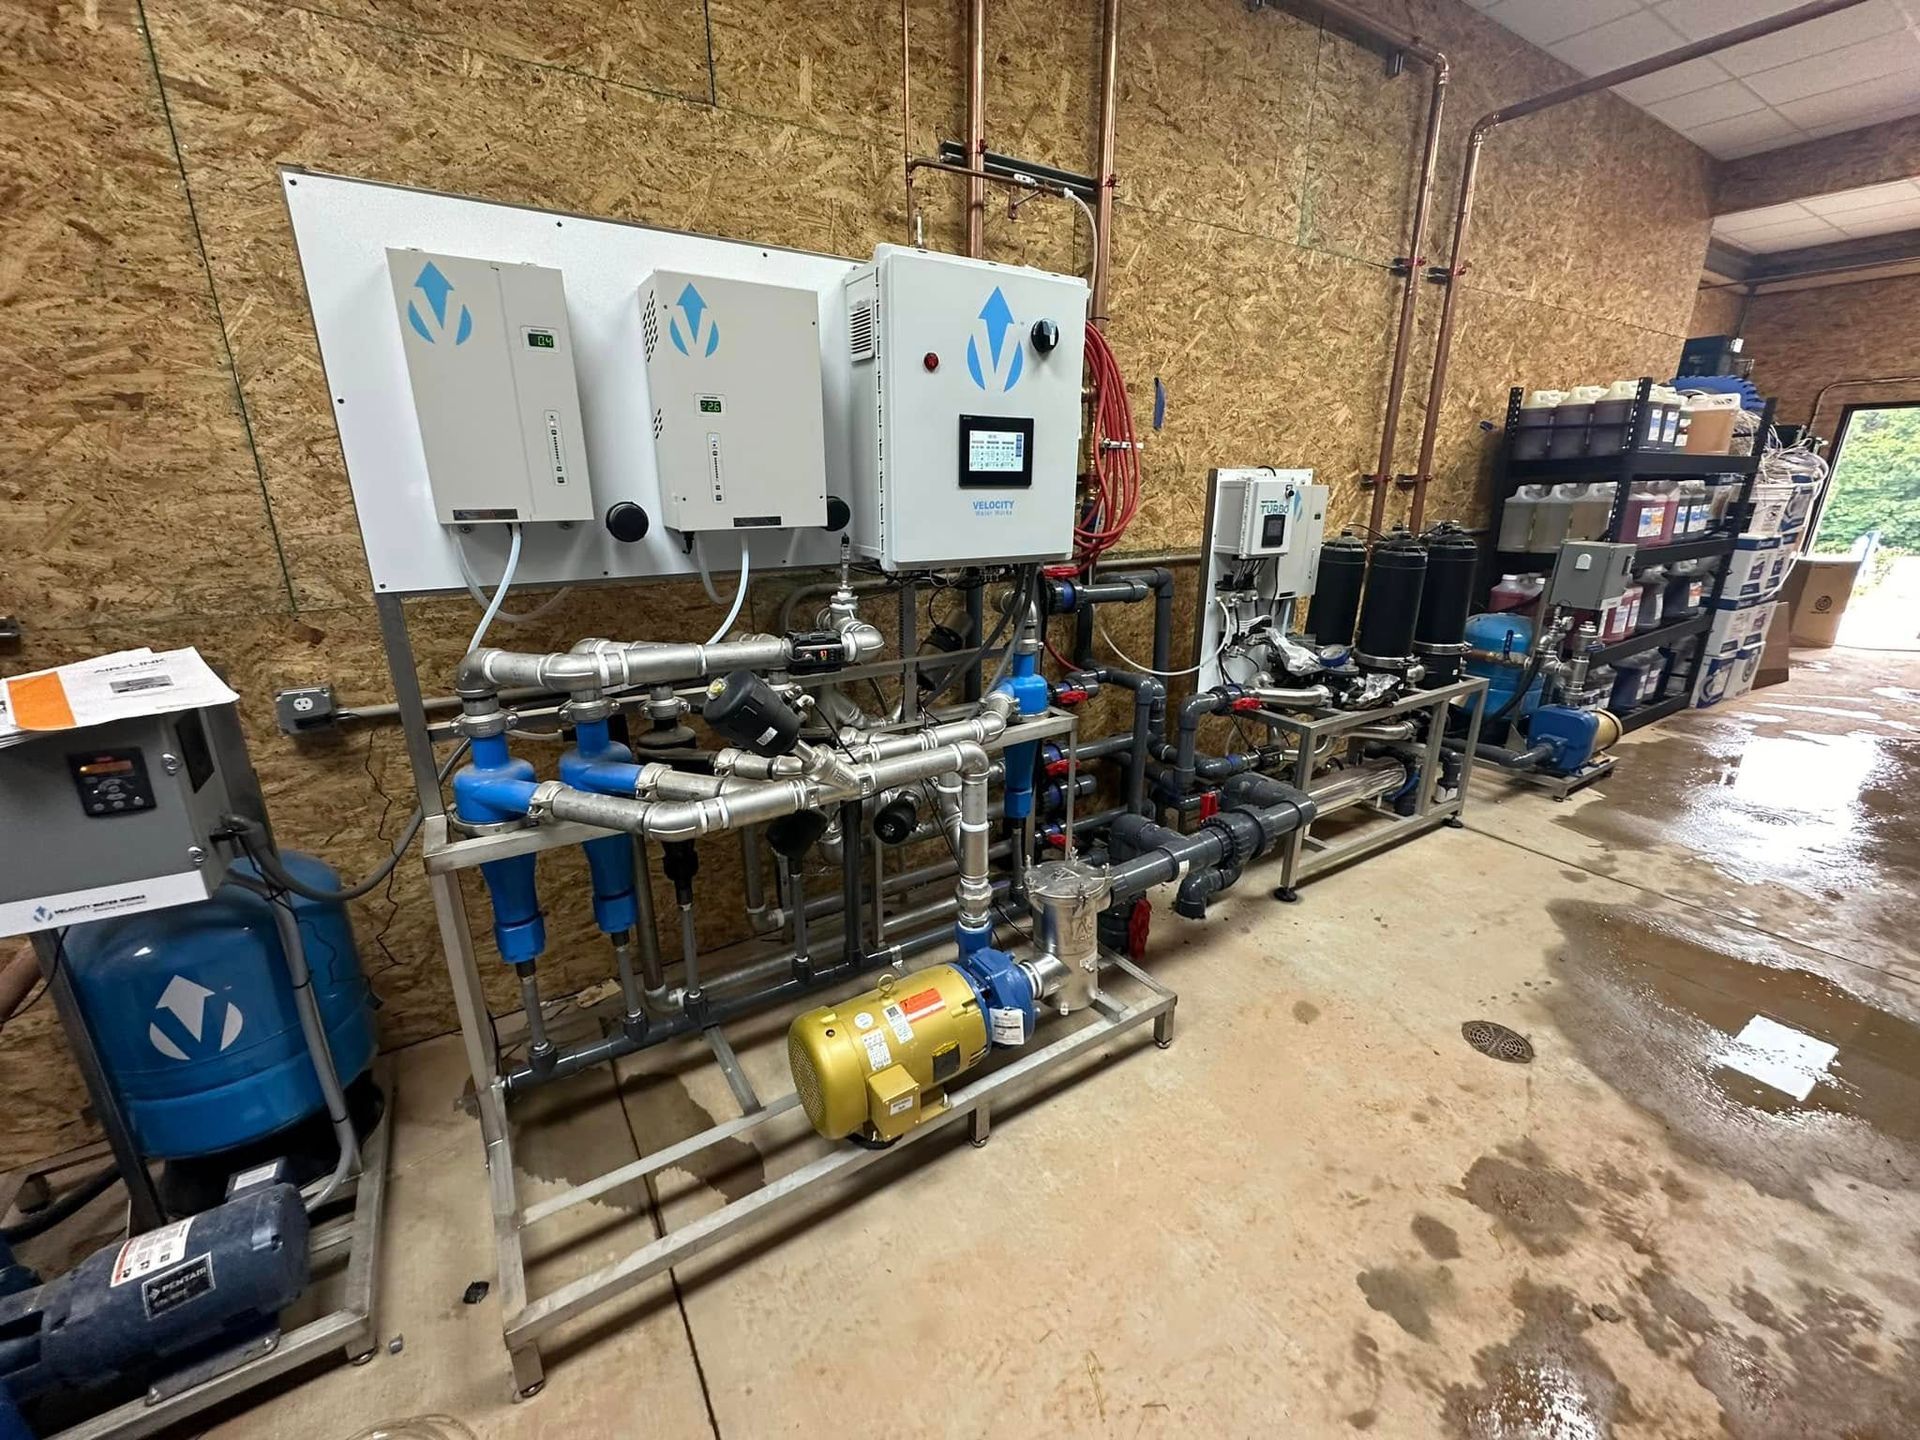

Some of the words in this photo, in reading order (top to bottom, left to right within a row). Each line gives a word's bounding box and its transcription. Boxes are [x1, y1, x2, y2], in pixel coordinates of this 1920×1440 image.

[973, 500, 1015, 510] VELOCITY
[1260, 504, 1289, 514] TURBO
[161, 1266, 207, 1292] PENTAIR
